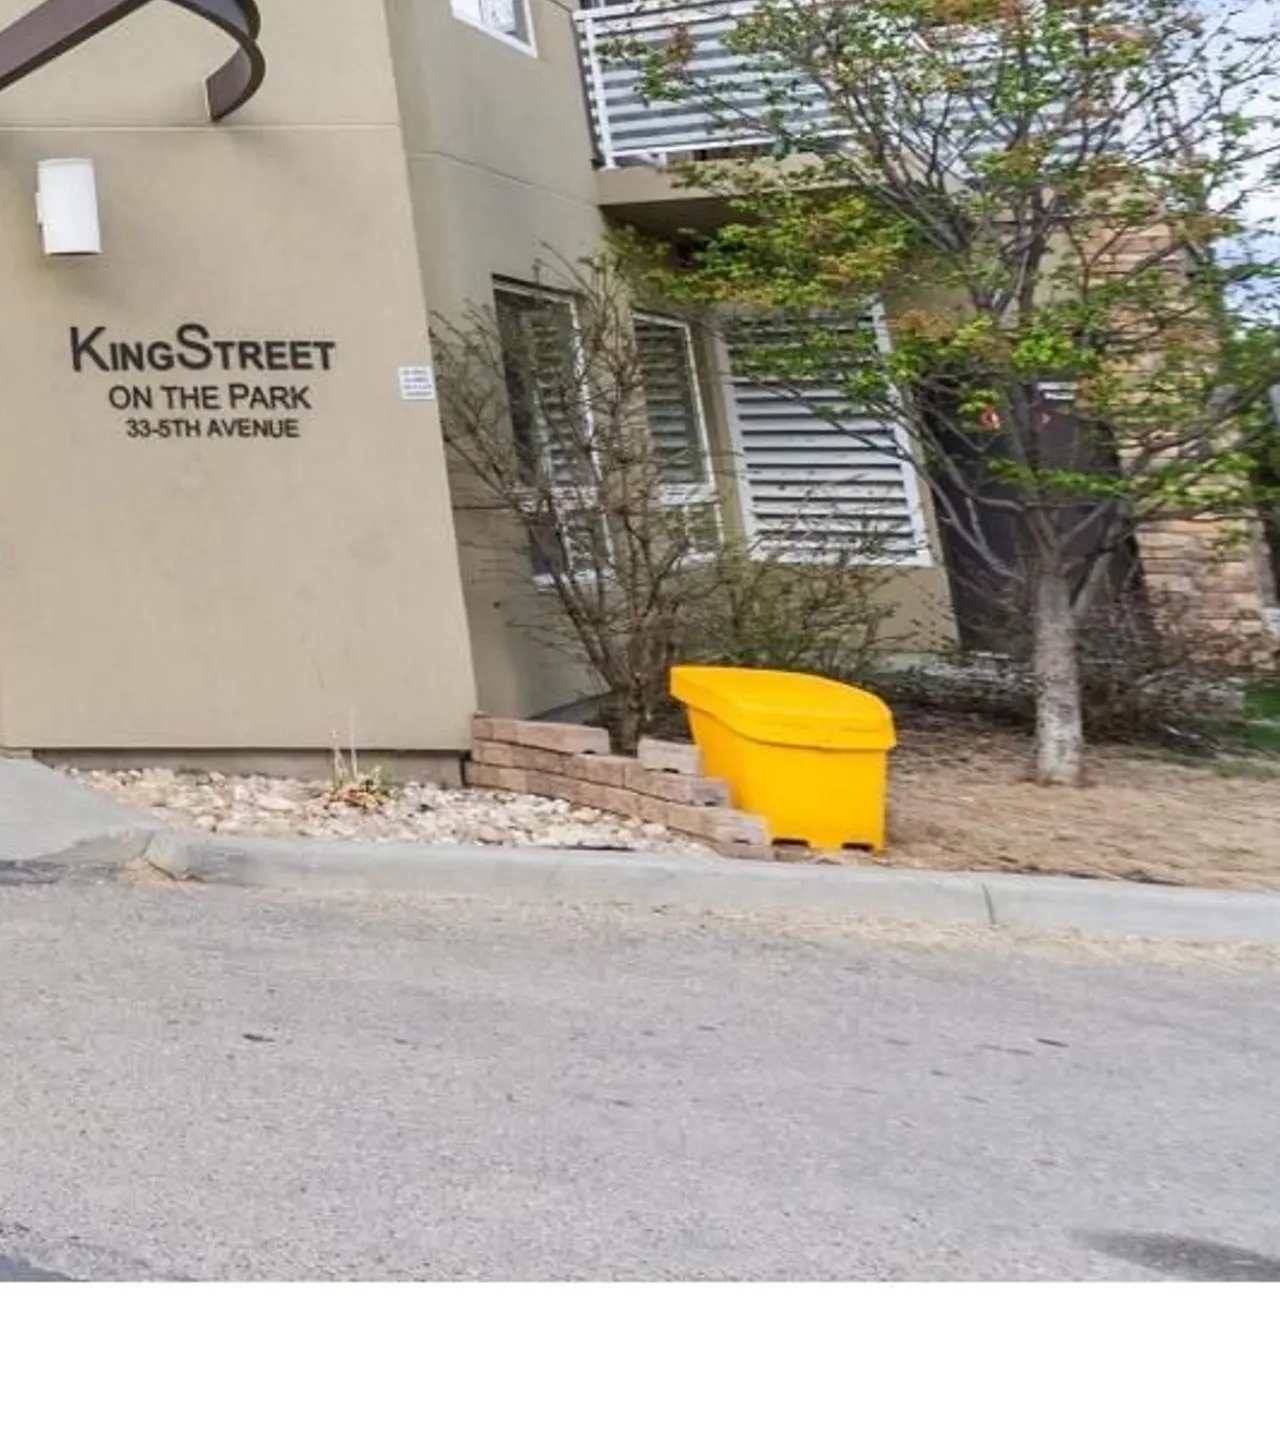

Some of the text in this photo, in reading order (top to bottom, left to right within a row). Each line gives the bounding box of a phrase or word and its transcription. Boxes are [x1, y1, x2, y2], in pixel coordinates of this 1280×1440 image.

[108, 383, 312, 410] ON THE PARK
[126, 418, 300, 438] 33-5TH AVENUE
